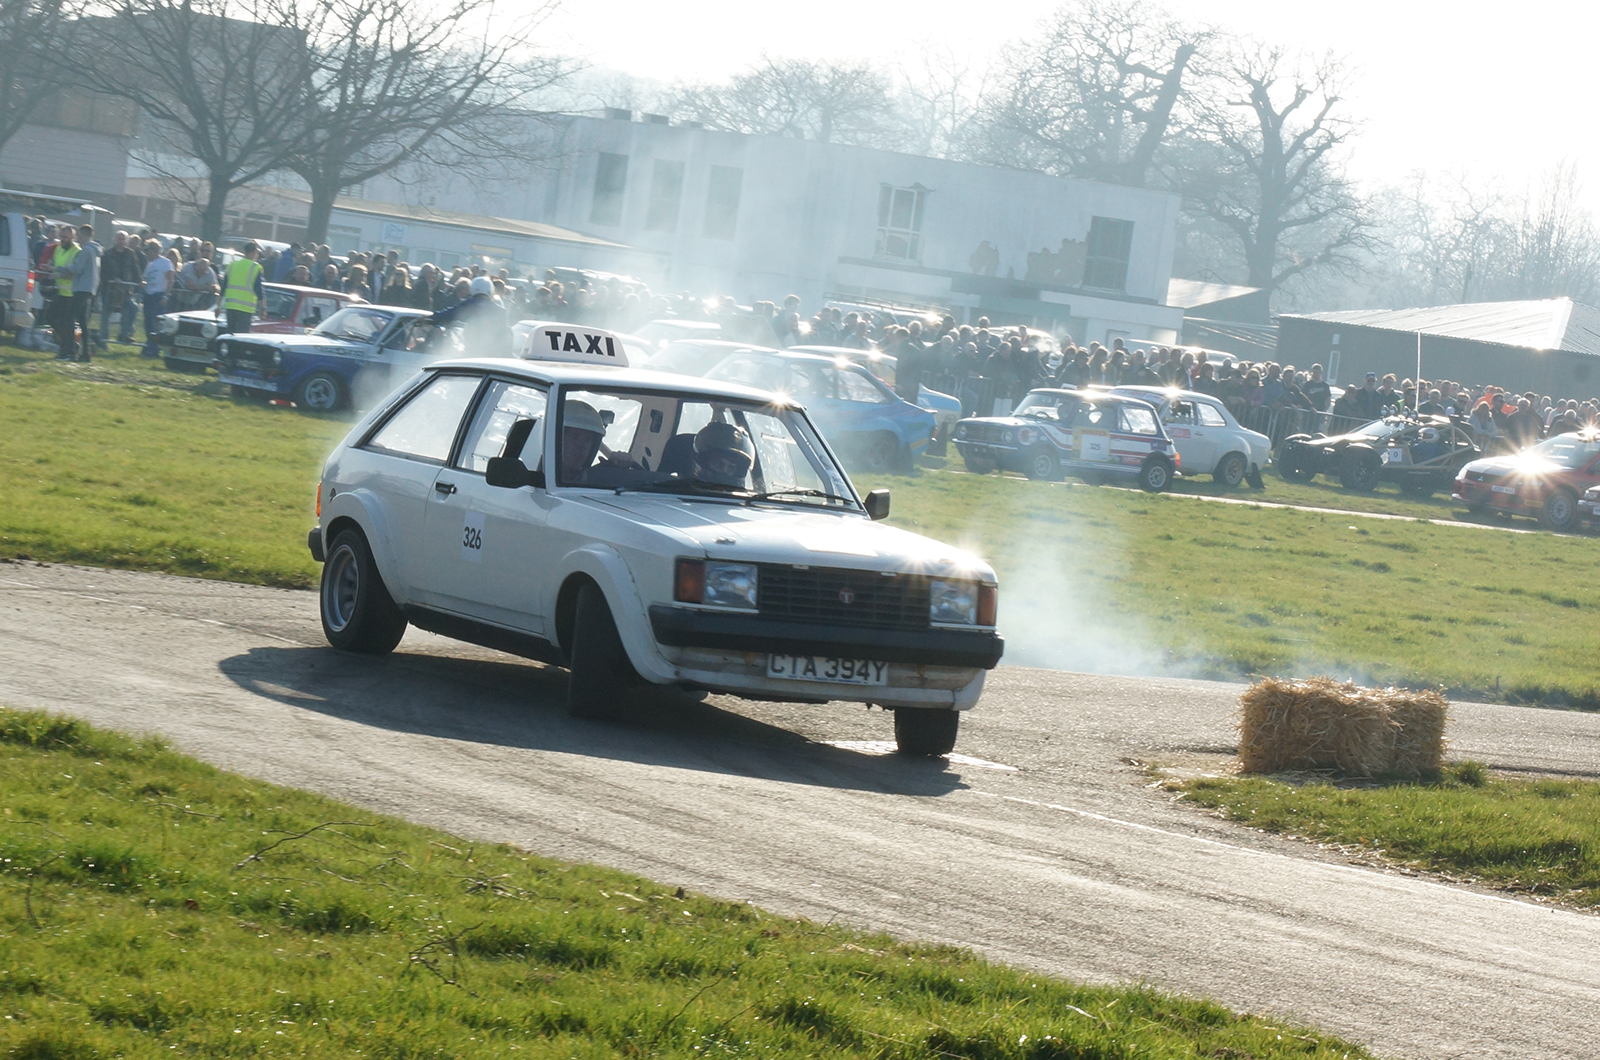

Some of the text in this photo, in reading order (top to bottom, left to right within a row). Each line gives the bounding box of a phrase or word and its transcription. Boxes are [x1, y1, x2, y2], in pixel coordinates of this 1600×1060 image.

[544, 330, 616, 357] TAXI
[463, 526, 482, 550] 326
[770, 653, 887, 682] CTA 394Y
